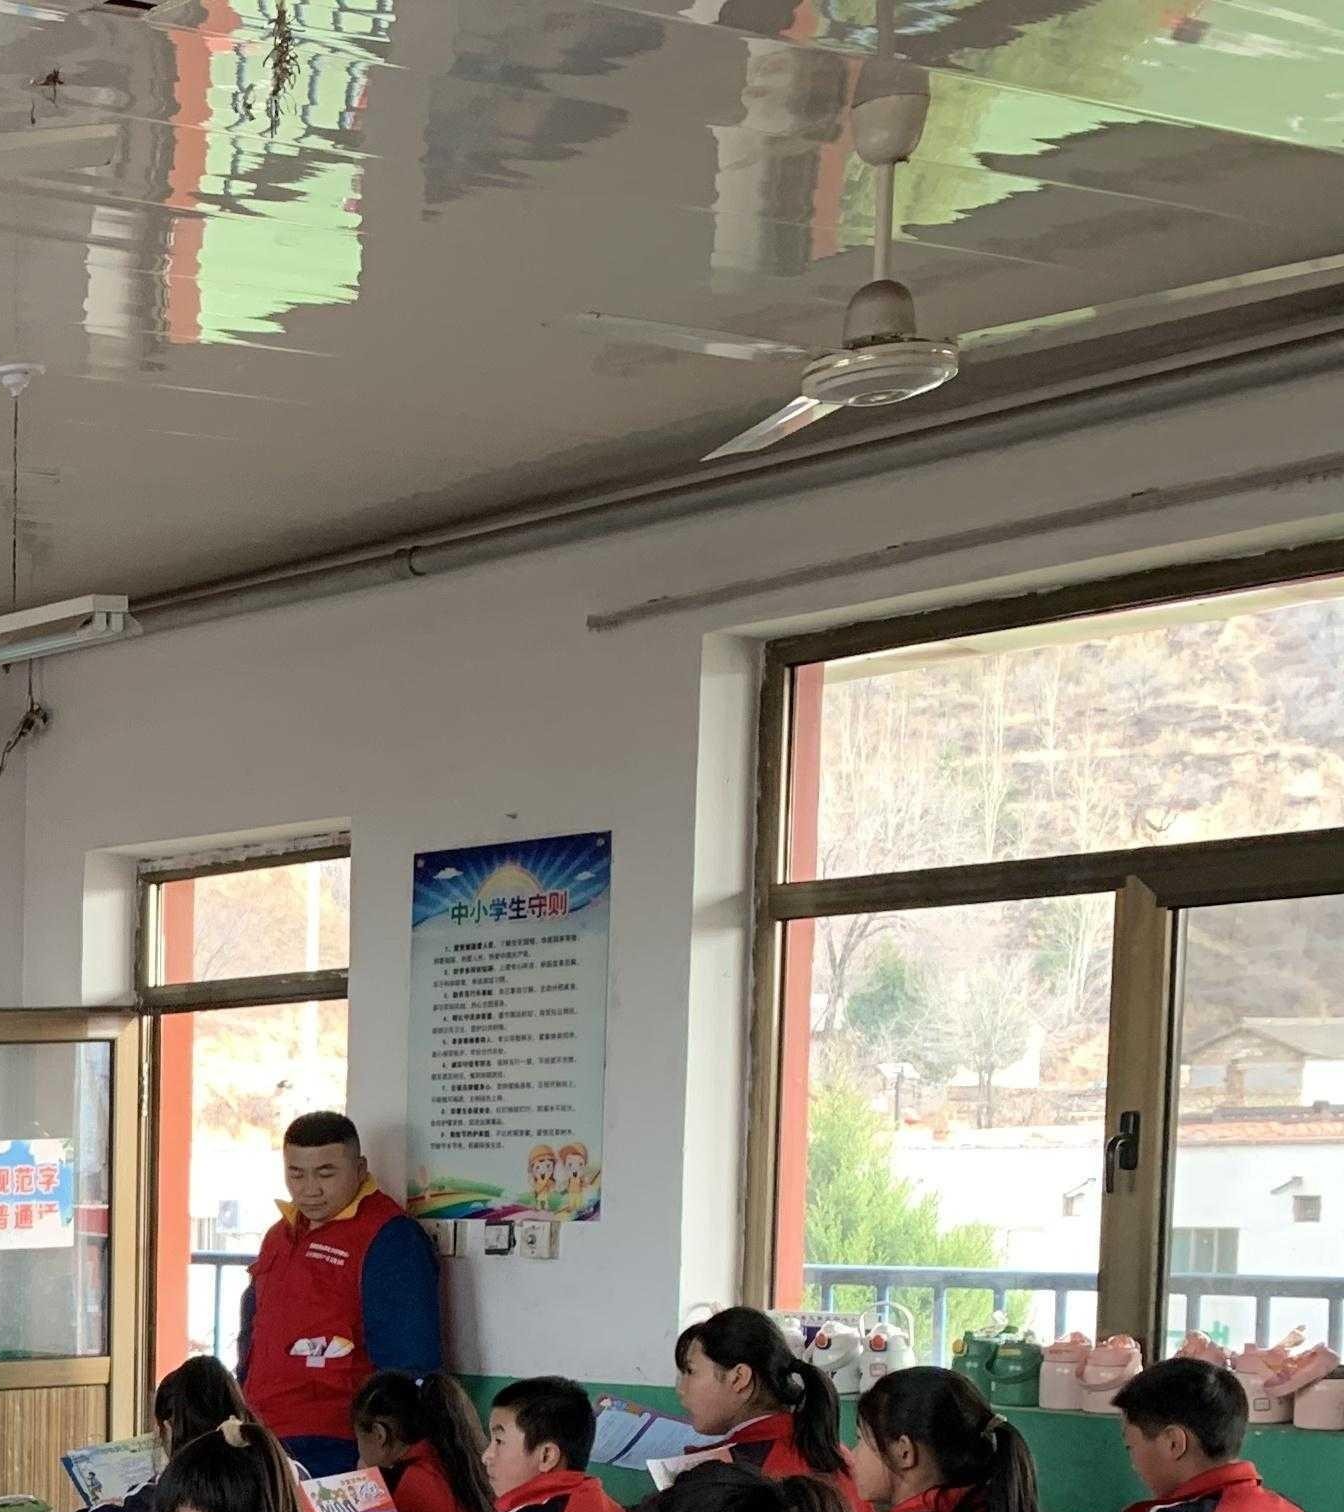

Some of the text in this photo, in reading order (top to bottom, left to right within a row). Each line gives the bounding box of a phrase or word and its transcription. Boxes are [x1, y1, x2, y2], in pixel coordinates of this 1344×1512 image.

[450, 891, 568, 927] 中小学生守则
